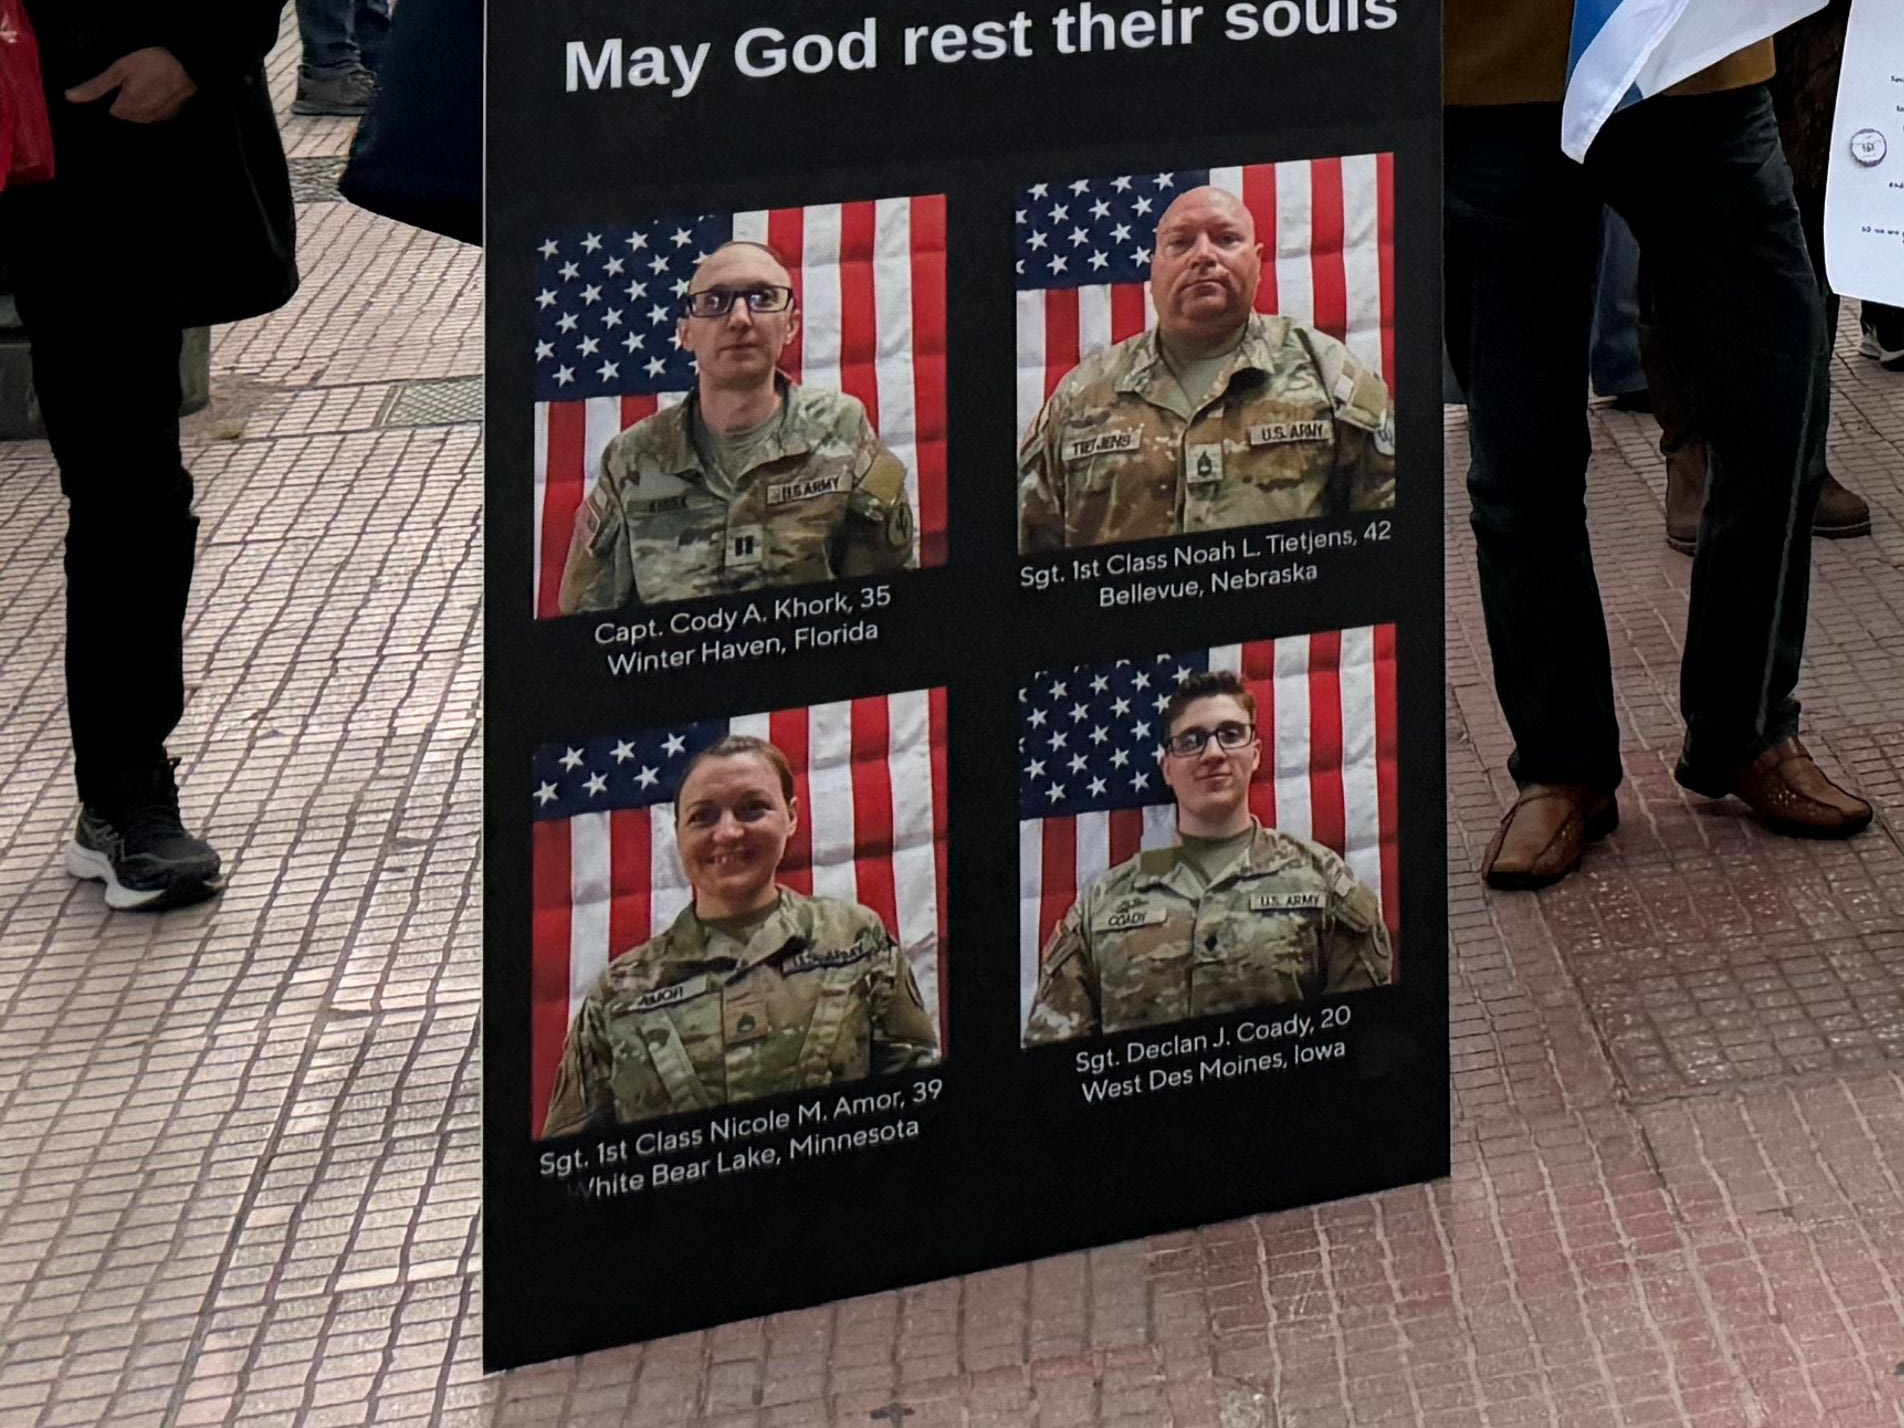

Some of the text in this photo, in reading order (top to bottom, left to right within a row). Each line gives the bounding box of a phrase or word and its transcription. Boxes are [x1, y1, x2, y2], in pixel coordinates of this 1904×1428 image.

[565, 37, 709, 96] May
[733, 16, 878, 74] God
[904, 10, 1032, 66] rest
[1020, 520, 1392, 591] Sgt. 1st Class Noah L. Tietjens, 42
[1099, 562, 1318, 608] Bellevue, Nebraska
[594, 585, 892, 647] Capt. Cody A. Khork, 35
[608, 621, 878, 676] Winter Haven, Florida
[1075, 1005, 1351, 1075] Sgt. Declan J. Coady, 20
[1082, 1040, 1345, 1103] West Des Moines, Iowa
[540, 1078, 943, 1178] Sgt. 1st Class Nicole M. Amor, 39
[652, 1159, 710, 1186] Bear
[717, 1146, 781, 1174] Lake,
[790, 1119, 919, 1159] Minnesota
